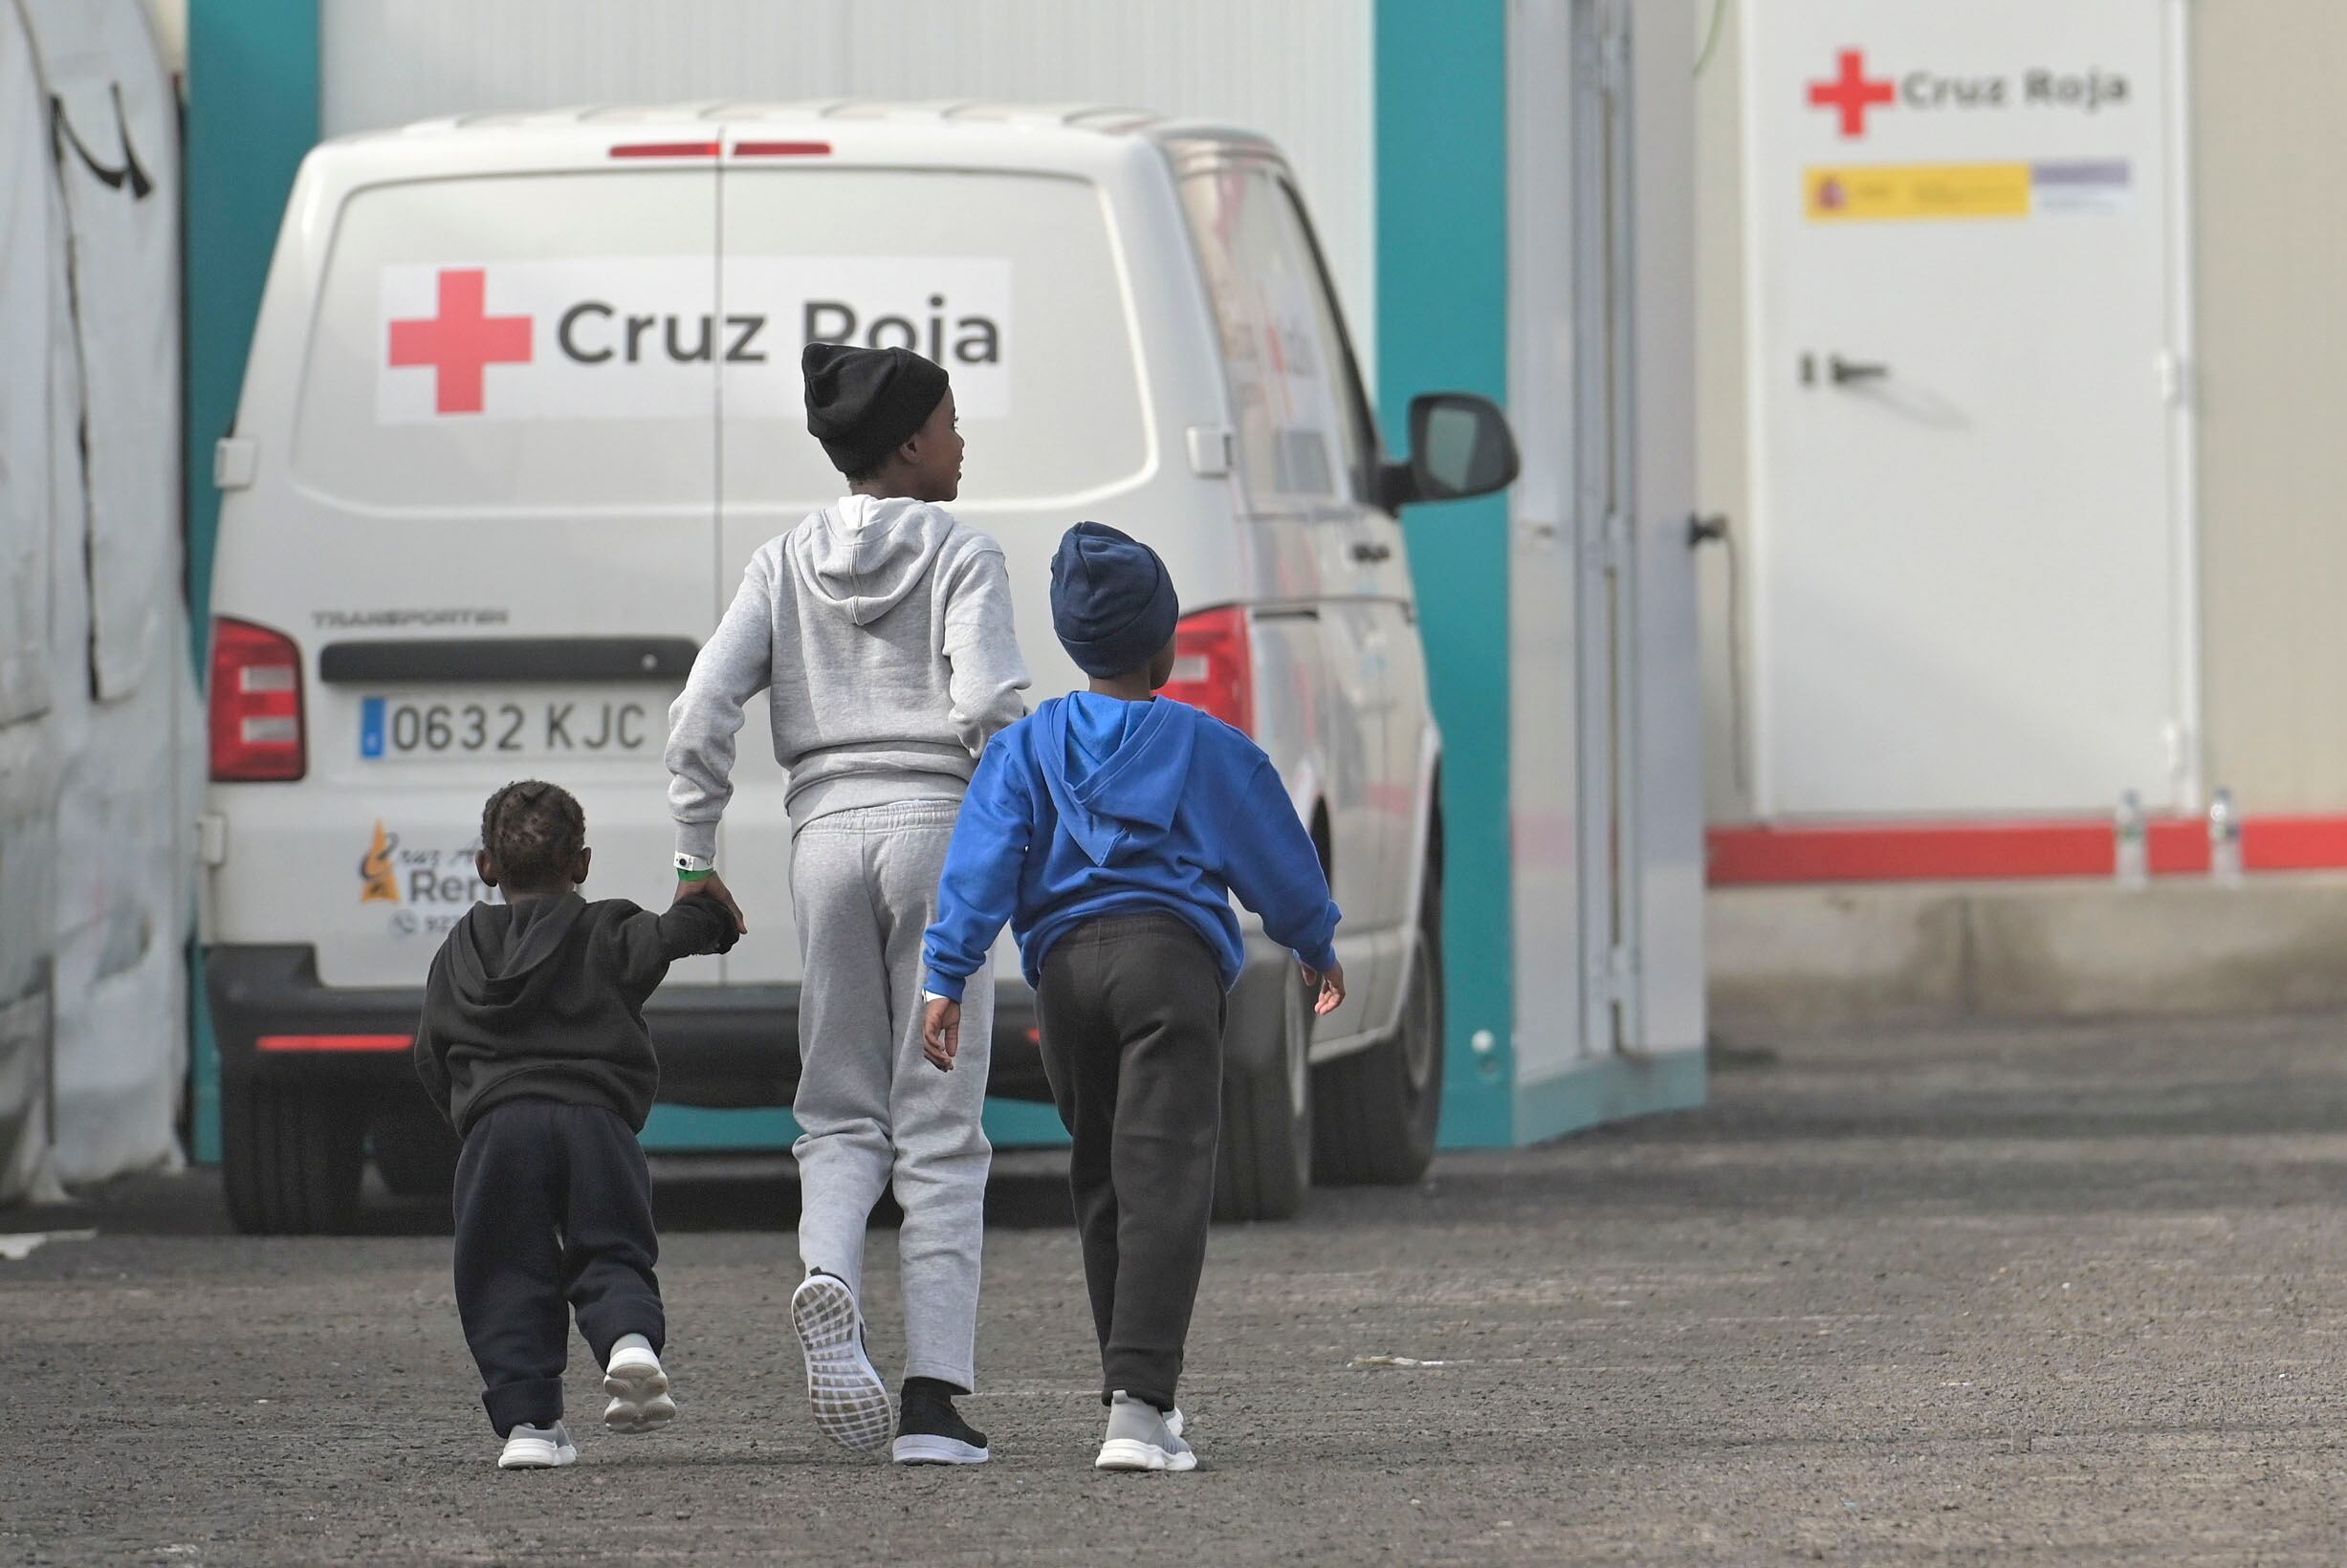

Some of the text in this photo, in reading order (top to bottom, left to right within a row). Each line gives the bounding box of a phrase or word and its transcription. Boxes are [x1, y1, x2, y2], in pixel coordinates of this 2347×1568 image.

[1902, 65, 2130, 114] Cruz Roja
[557, 293, 1000, 364] Cruz Roja
[392, 701, 646, 751] 0632 KJC
